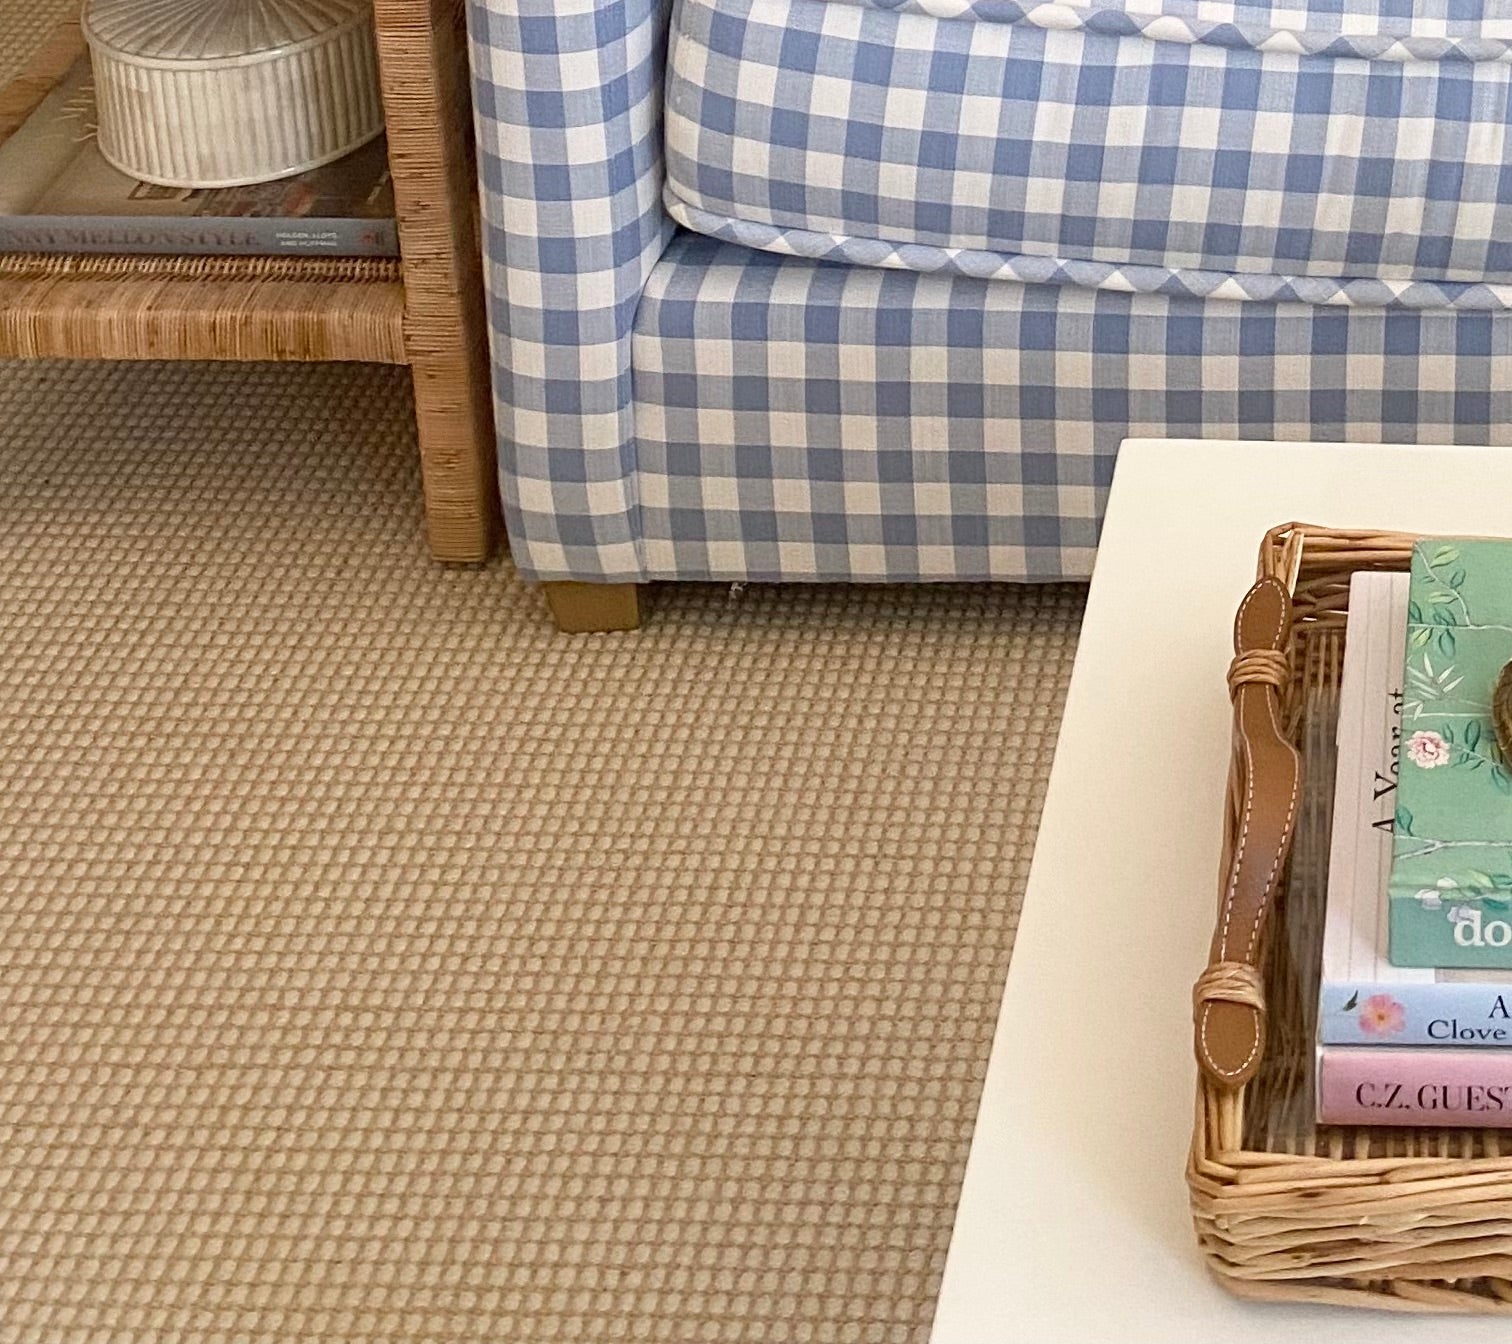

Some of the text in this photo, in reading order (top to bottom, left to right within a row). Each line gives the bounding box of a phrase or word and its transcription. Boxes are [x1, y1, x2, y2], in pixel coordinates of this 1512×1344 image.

[179, 229, 260, 246] STYLE
[1371, 818, 1395, 835] A
[1487, 994, 1512, 1019] A
[1426, 1018, 1508, 1041] Clove
[1355, 1082, 1411, 1110] C.Z.
